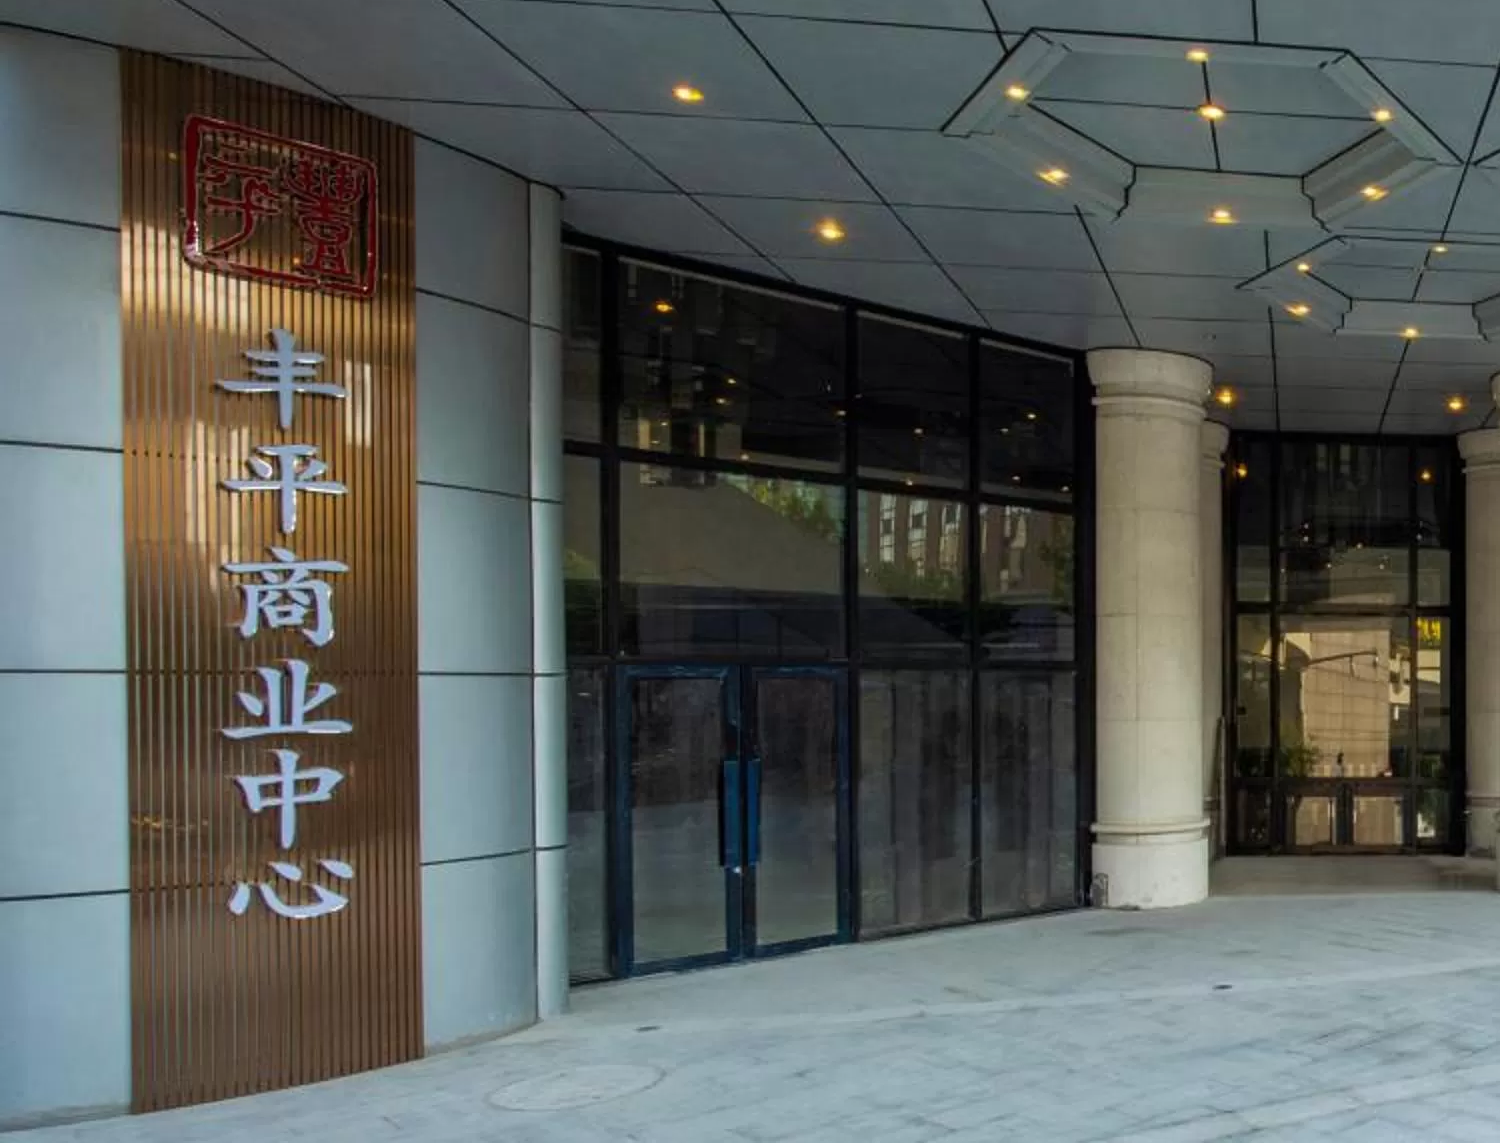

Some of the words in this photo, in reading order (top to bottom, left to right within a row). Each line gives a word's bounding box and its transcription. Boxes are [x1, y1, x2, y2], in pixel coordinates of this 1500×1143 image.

[217, 328, 353, 919] 丰平商业中心
